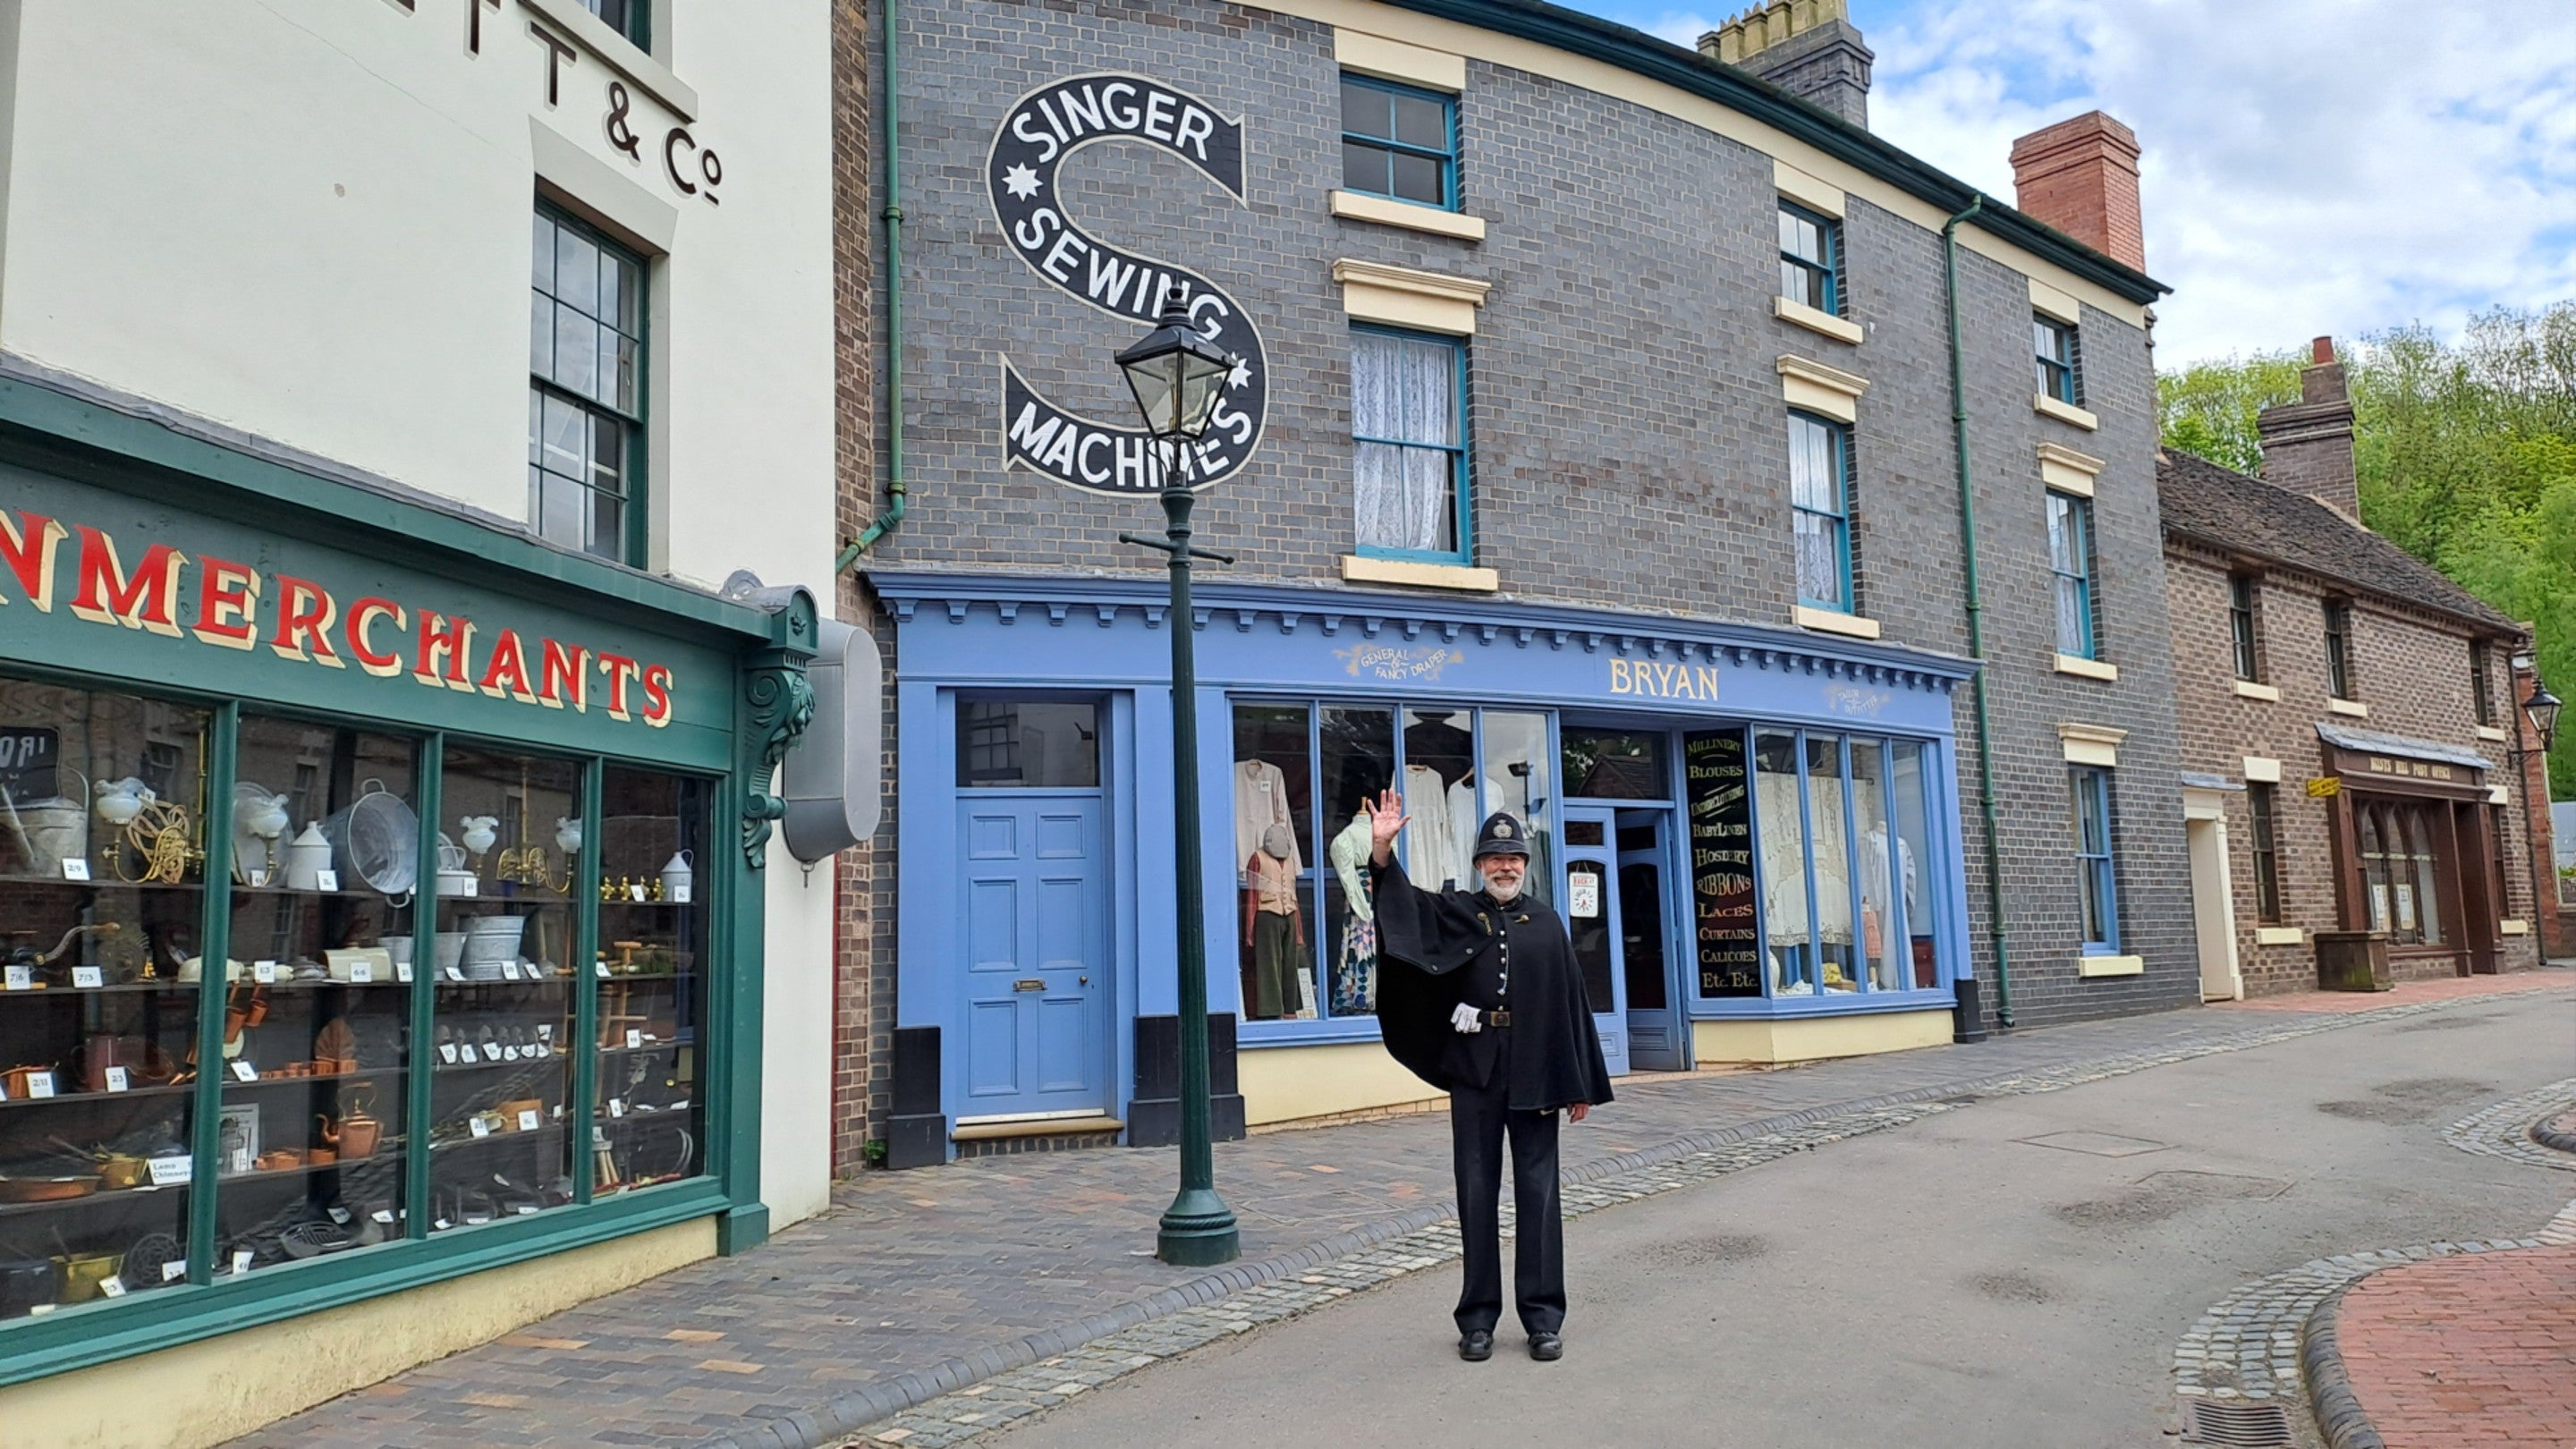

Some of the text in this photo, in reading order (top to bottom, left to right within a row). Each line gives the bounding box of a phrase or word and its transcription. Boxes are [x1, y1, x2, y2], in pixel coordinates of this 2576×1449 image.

[605, 80, 642, 165] &
[1013, 82, 1214, 164] SINGER
[1014, 208, 1229, 342] SEWING
[1008, 396, 1252, 488] MACHINES
[1361, 648, 1410, 667] GENERAL
[1375, 648, 1447, 680] FANCY DRAPER
[1609, 658, 1719, 701] BRYAN
[1687, 738, 1741, 756] MILLINERY
[1689, 765, 1744, 778] BLOUSES
[1694, 848, 1750, 868] HOSIERY
[1697, 873, 1751, 895] RIBBONS
[1699, 902, 1753, 918] LACES
[1699, 927, 1756, 940] CURTAINS
[1701, 949, 1757, 962] CALICOES
